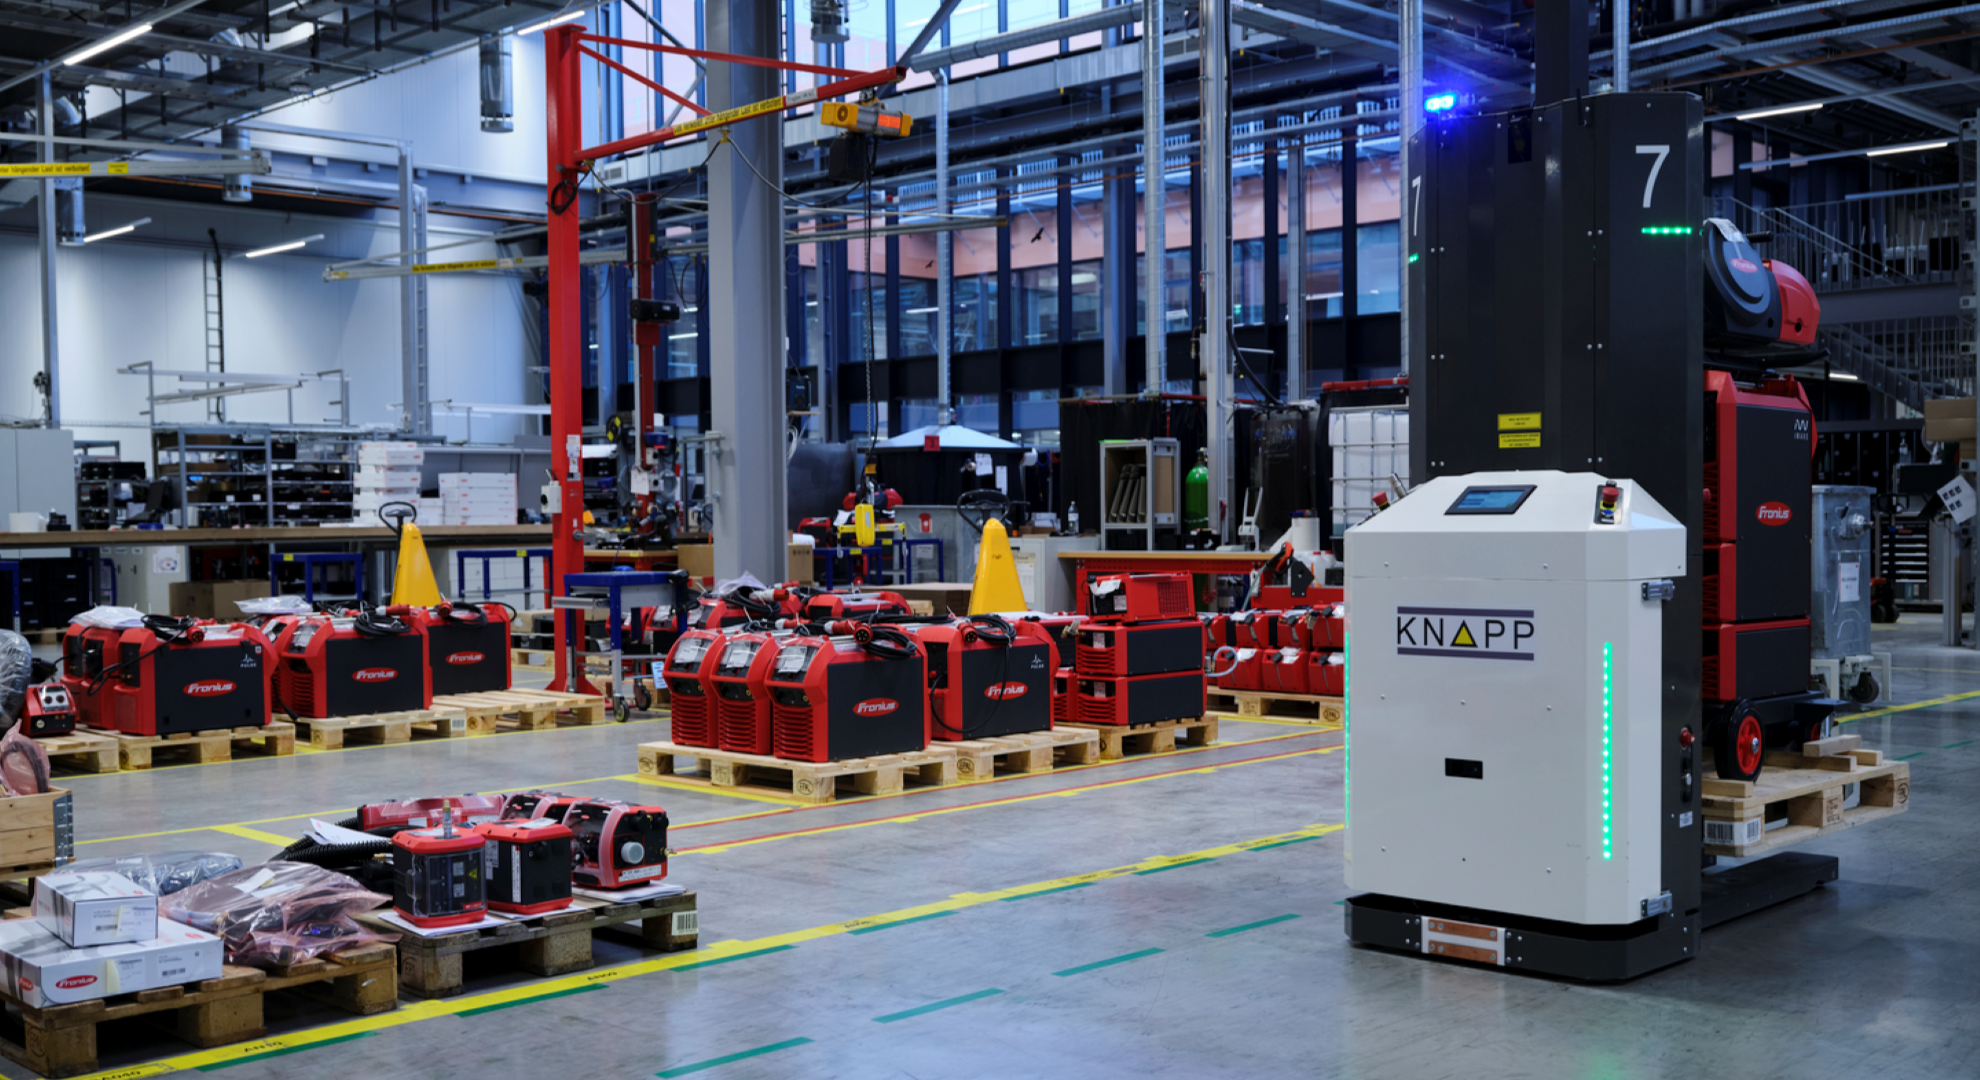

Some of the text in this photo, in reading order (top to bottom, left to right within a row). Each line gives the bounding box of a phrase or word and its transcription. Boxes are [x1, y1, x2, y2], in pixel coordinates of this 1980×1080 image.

[1635, 144, 1670, 209] 7
[1758, 505, 1790, 519] Fronius
[1397, 616, 1534, 650] KNAPP
[449, 653, 482, 663] Fronius
[356, 669, 395, 680] Fronius
[187, 682, 233, 694] Fronius
[857, 700, 896, 713] Fronius
[59, 976, 94, 988] Fronius
